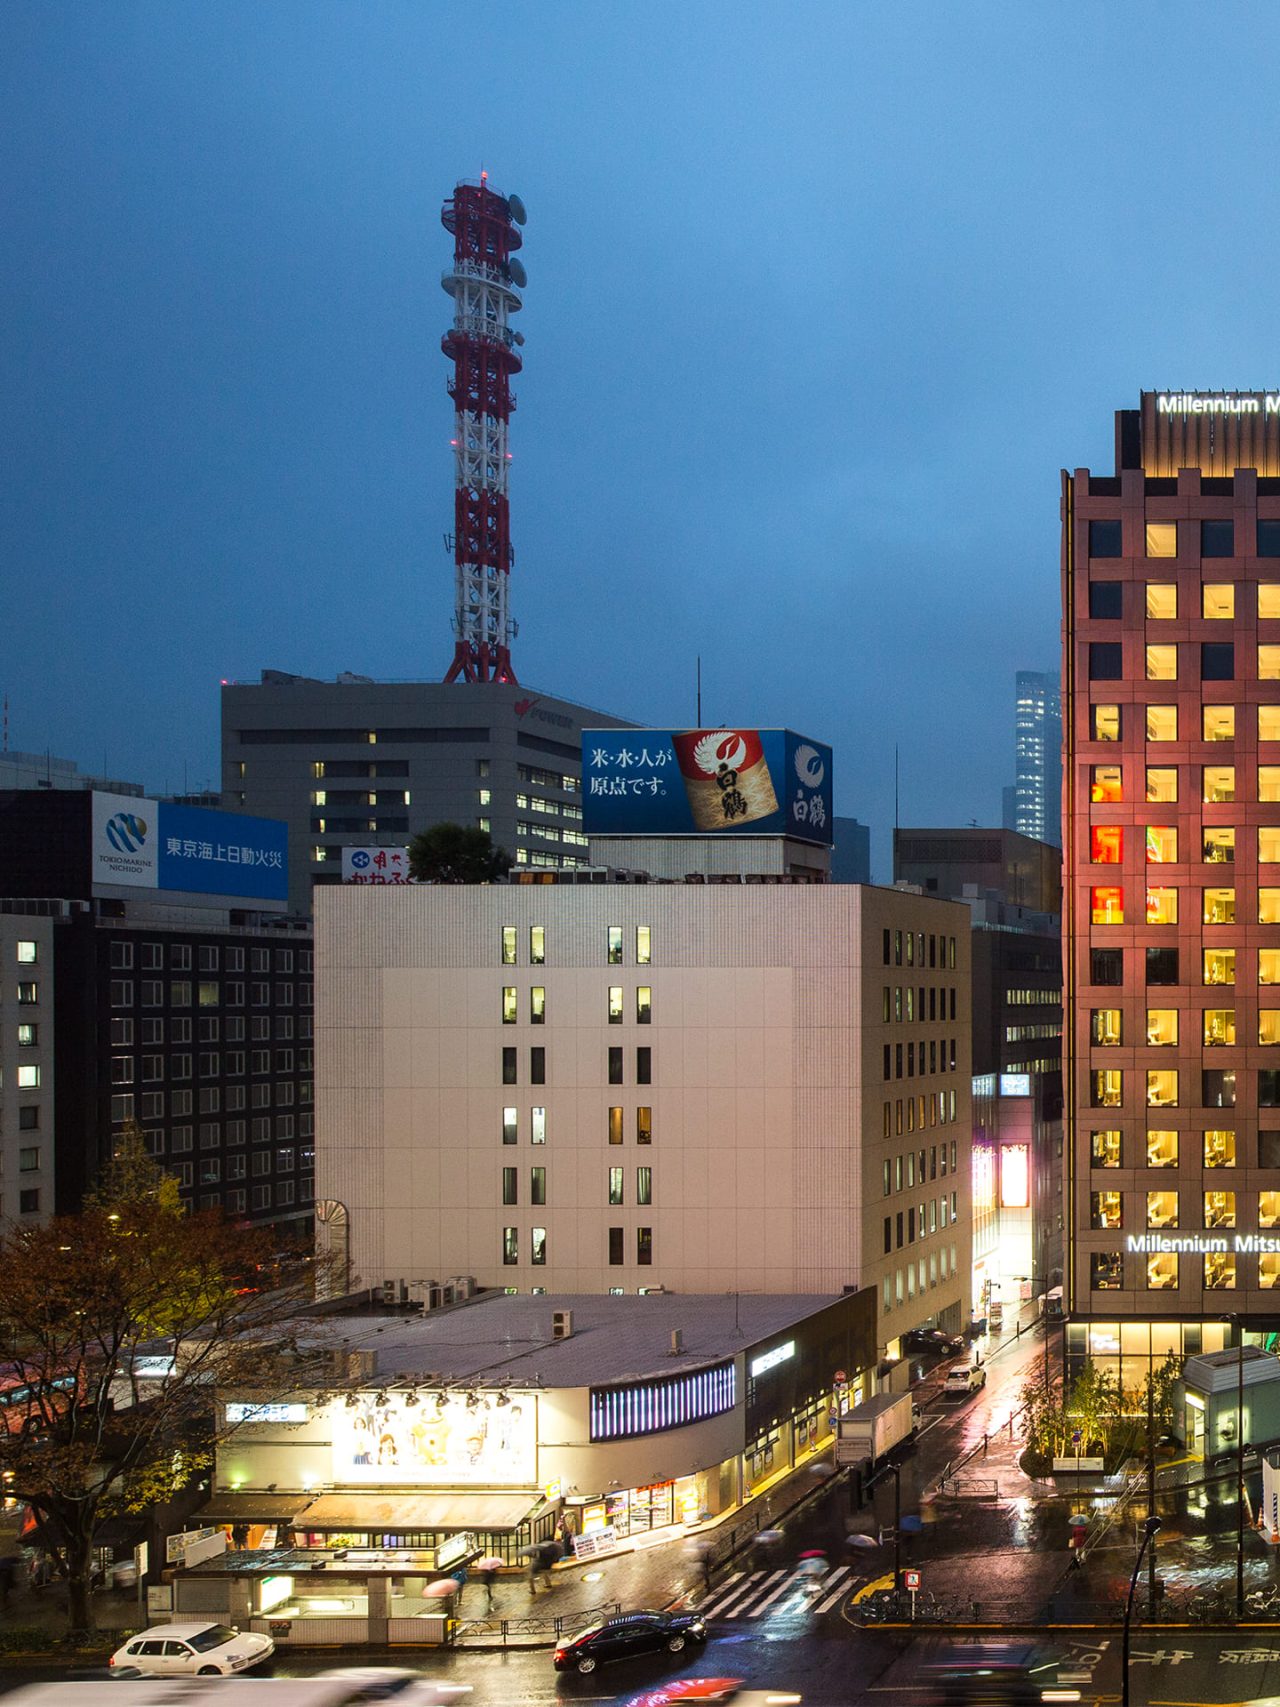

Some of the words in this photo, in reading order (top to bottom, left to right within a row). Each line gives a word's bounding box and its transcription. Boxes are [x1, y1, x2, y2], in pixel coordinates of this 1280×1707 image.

[1158, 396, 1259, 413] Millennium
[590, 776, 667, 796] 原点です。
[166, 838, 282, 869] 東京海上日動火災
[109, 864, 143, 874] NICHIDO
[1127, 1235, 1227, 1252] Millennium
